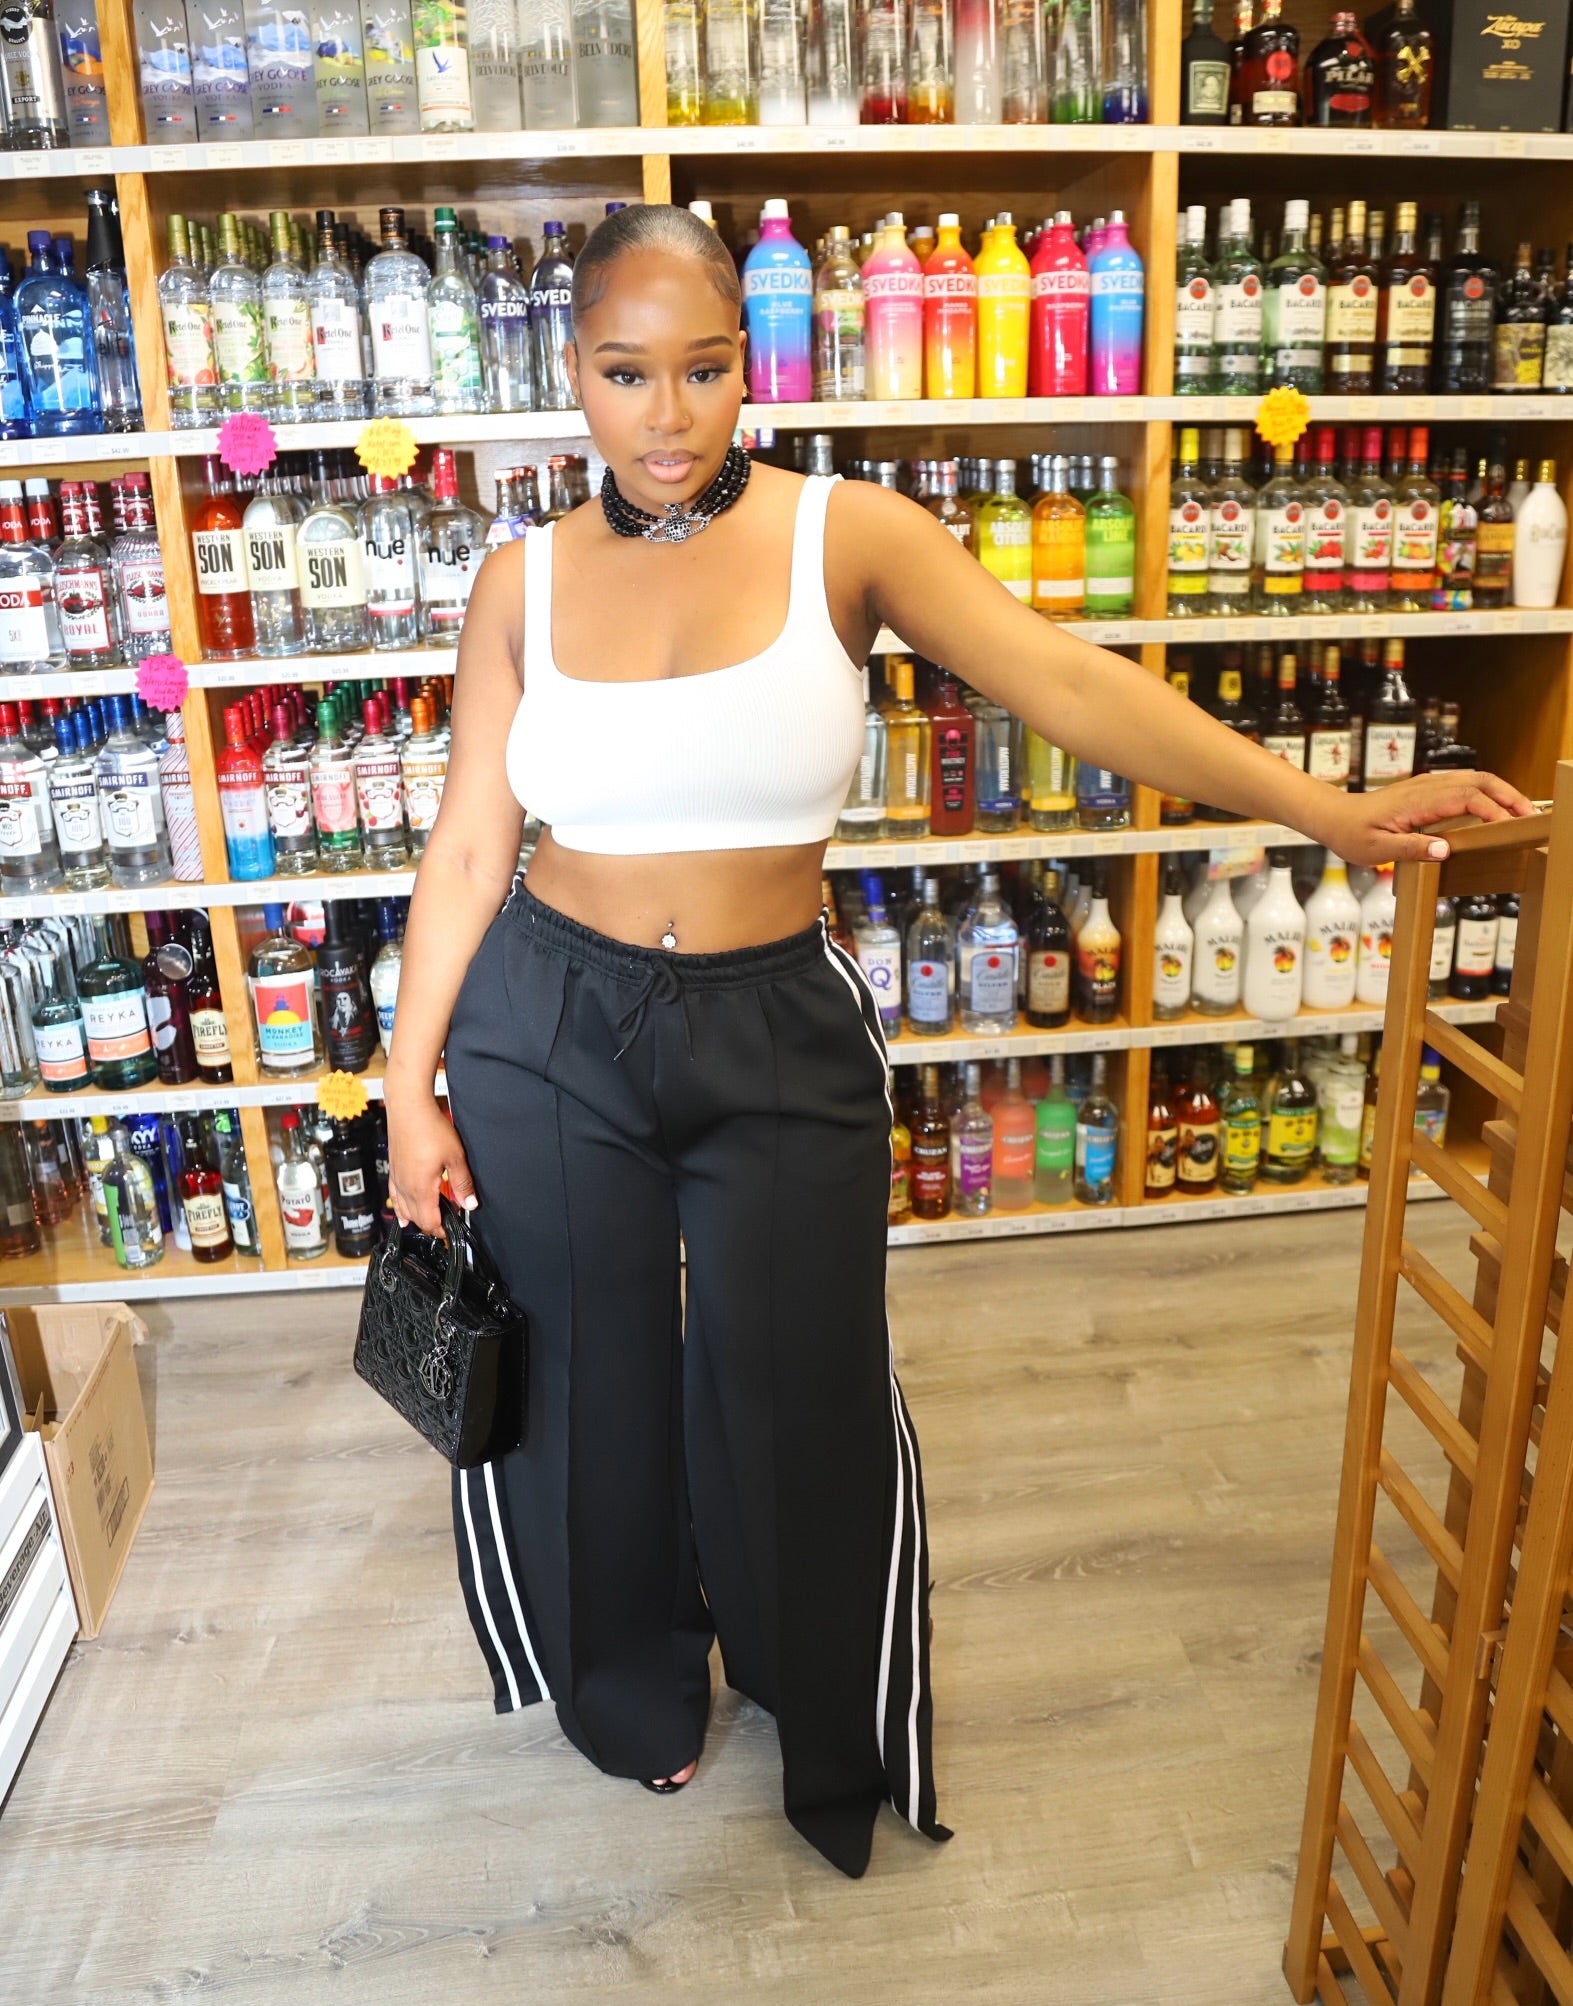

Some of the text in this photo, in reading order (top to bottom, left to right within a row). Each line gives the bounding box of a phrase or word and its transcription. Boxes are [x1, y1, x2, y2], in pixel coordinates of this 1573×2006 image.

[580, 43, 633, 58] BELVDERE
[14, 96, 37, 104] EXPORT
[534, 289, 572, 306] SVED
[22, 312, 62, 325] PINNACLE
[405, 324, 420, 334] One
[249, 531, 283, 540] WESTERN
[1170, 524, 1206, 534] BACARD
[196, 534, 230, 544] WESTERN
[250, 540, 286, 570] SON
[308, 548, 344, 556] WESTERN
[366, 540, 404, 559] nue
[429, 544, 470, 566] nue
[198, 544, 234, 574] SON
[309, 556, 348, 588] SON
[0, 594, 30, 608] ODA
[356, 764, 398, 776] SMIRNOFF
[905, 752, 917, 798] AMSTERDAM
[998, 746, 1010, 792] AMSTERDAM
[100, 774, 146, 786] SMIRNOFF
[161, 774, 190, 785] SMIRNO
[218, 772, 258, 783] SMIRNOFF
[265, 772, 302, 783] MIRNOFF
[52, 784, 94, 799] SMIRNOFF
[1320, 920, 1360, 936] MALIB
[868, 958, 892, 966] DON
[870, 967, 892, 990] Q
[90, 1010, 136, 1024] REYKA
[266, 1026, 303, 1036] MONKEY
[132, 1128, 158, 1144] KYY
[376, 1159, 390, 1174] SK
[187, 1206, 222, 1222] FIREFLY
